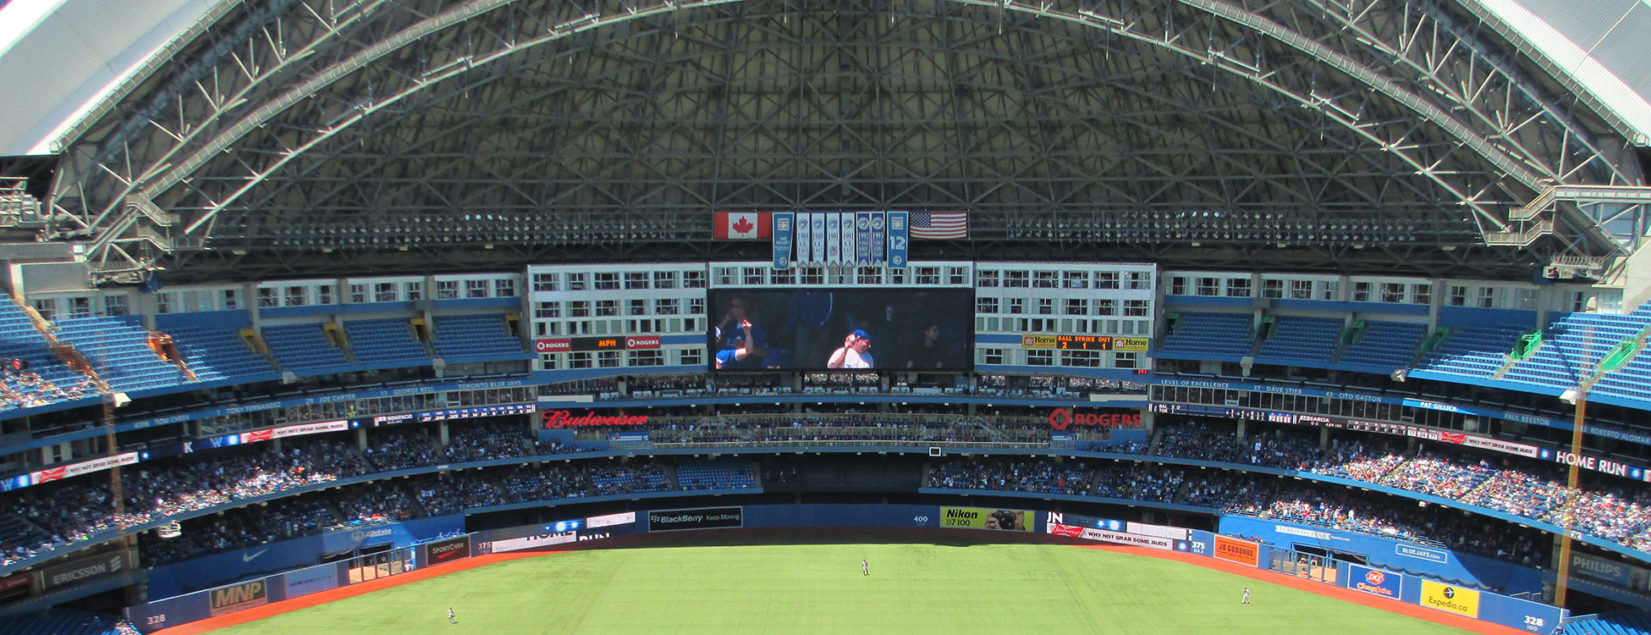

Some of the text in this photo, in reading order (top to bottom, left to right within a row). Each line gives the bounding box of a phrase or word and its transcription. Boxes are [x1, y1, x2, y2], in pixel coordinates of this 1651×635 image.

[889, 236, 906, 250] 12
[598, 339, 617, 347] MPH
[1034, 336, 1056, 344] Home
[1082, 342, 1087, 350] 1
[1191, 381, 1230, 389] EXCELLENCE
[332, 393, 356, 401] CARTER
[1354, 393, 1382, 403] GASTON
[1420, 401, 1433, 409] PAT
[542, 409, 648, 429] Budweiser
[1074, 413, 1142, 426] ROGERS
[1504, 413, 1550, 426] PAUL BEESTON
[1590, 427, 1619, 439] ROBERTO
[183, 441, 193, 454] K
[1556, 450, 1627, 477] HOME RUN
[660, 514, 703, 523] BlackBerry
[946, 509, 978, 519] Nikon
[946, 518, 970, 527] D7100
[478, 541, 491, 549] 375
[1192, 541, 1206, 550] 375
[1572, 556, 1622, 577] PHILIPS
[53, 563, 106, 584] ERICSSON
[1368, 574, 1382, 582] DQ
[215, 582, 262, 608] MNP
[1428, 595, 1468, 612] Expedia.ca
[147, 614, 166, 625] 328
[1523, 615, 1544, 627] 328
